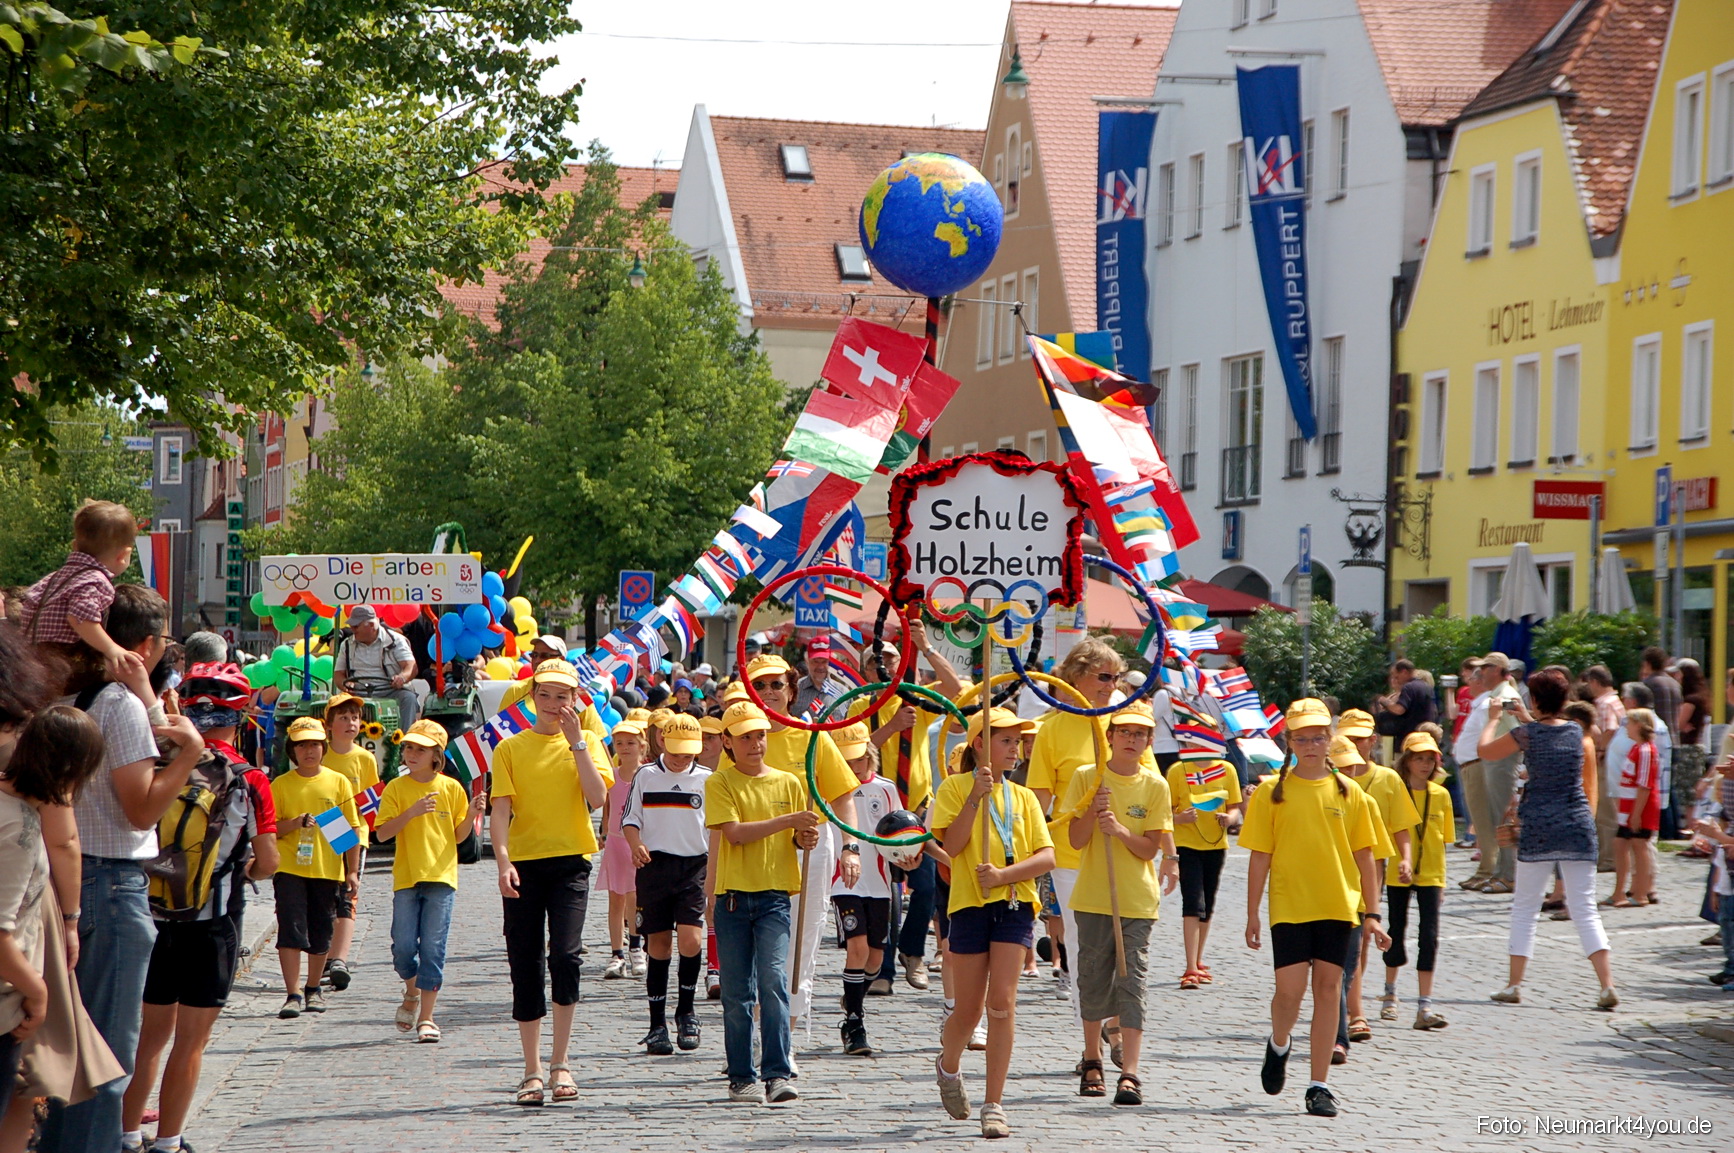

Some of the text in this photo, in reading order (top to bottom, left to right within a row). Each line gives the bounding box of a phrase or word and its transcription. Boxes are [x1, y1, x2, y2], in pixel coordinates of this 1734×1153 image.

[1279, 205, 1307, 338] RUPPERT
[1487, 299, 1537, 347] HOTEL
[928, 493, 1049, 531] Schule
[1536, 492, 1602, 507] WISSMAC
[1478, 517, 1546, 548] Restaurant
[227, 502, 241, 622] APOTHEKE
[327, 556, 447, 576] Die Farben
[915, 540, 1063, 576] Holzheim
[333, 581, 443, 604] Olympia's
[798, 607, 829, 623] TAXI
